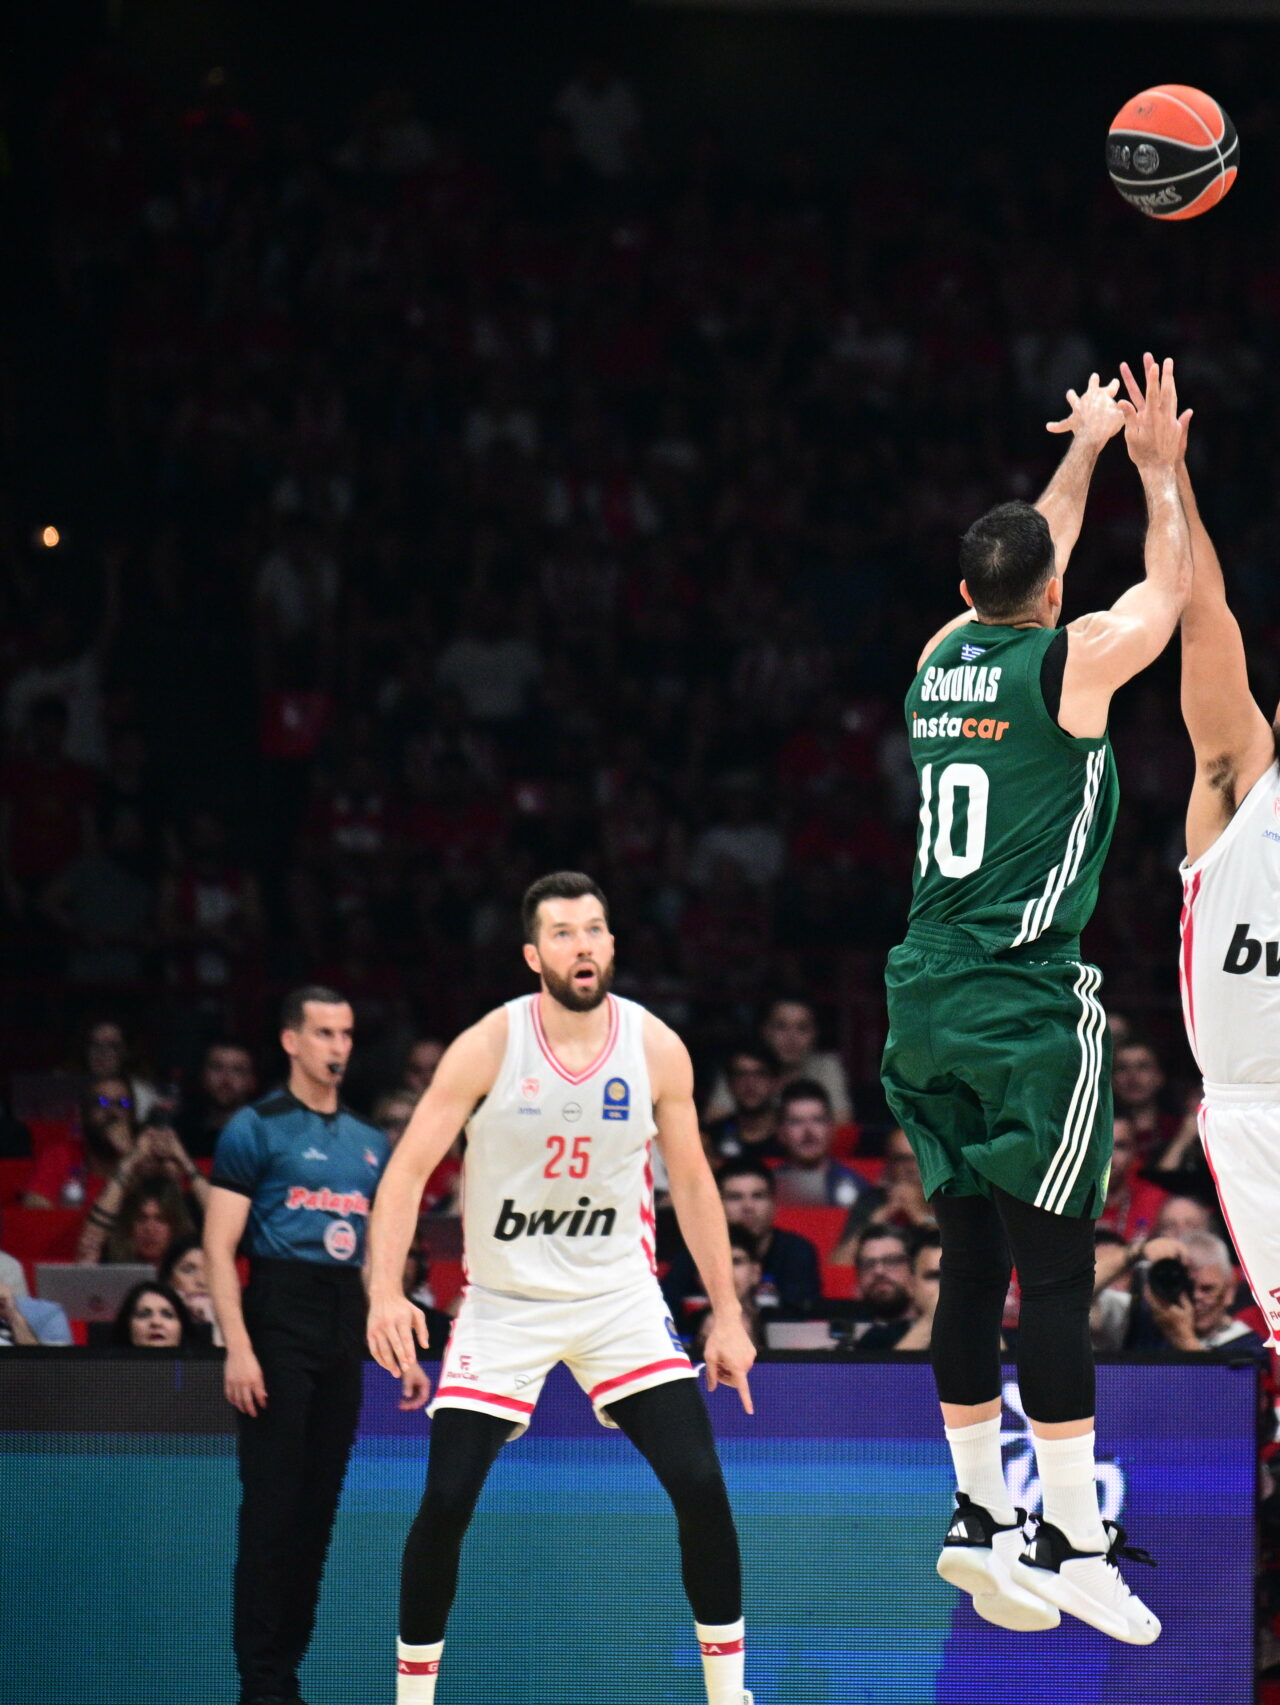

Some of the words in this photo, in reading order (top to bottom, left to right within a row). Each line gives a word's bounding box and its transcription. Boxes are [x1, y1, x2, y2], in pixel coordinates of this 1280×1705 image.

[921, 666, 1002, 703] SLOUKAS
[912, 711, 1010, 741] instacar
[919, 763, 990, 879] 10
[543, 1135, 592, 1179] 25
[493, 1196, 616, 1241] bwin
